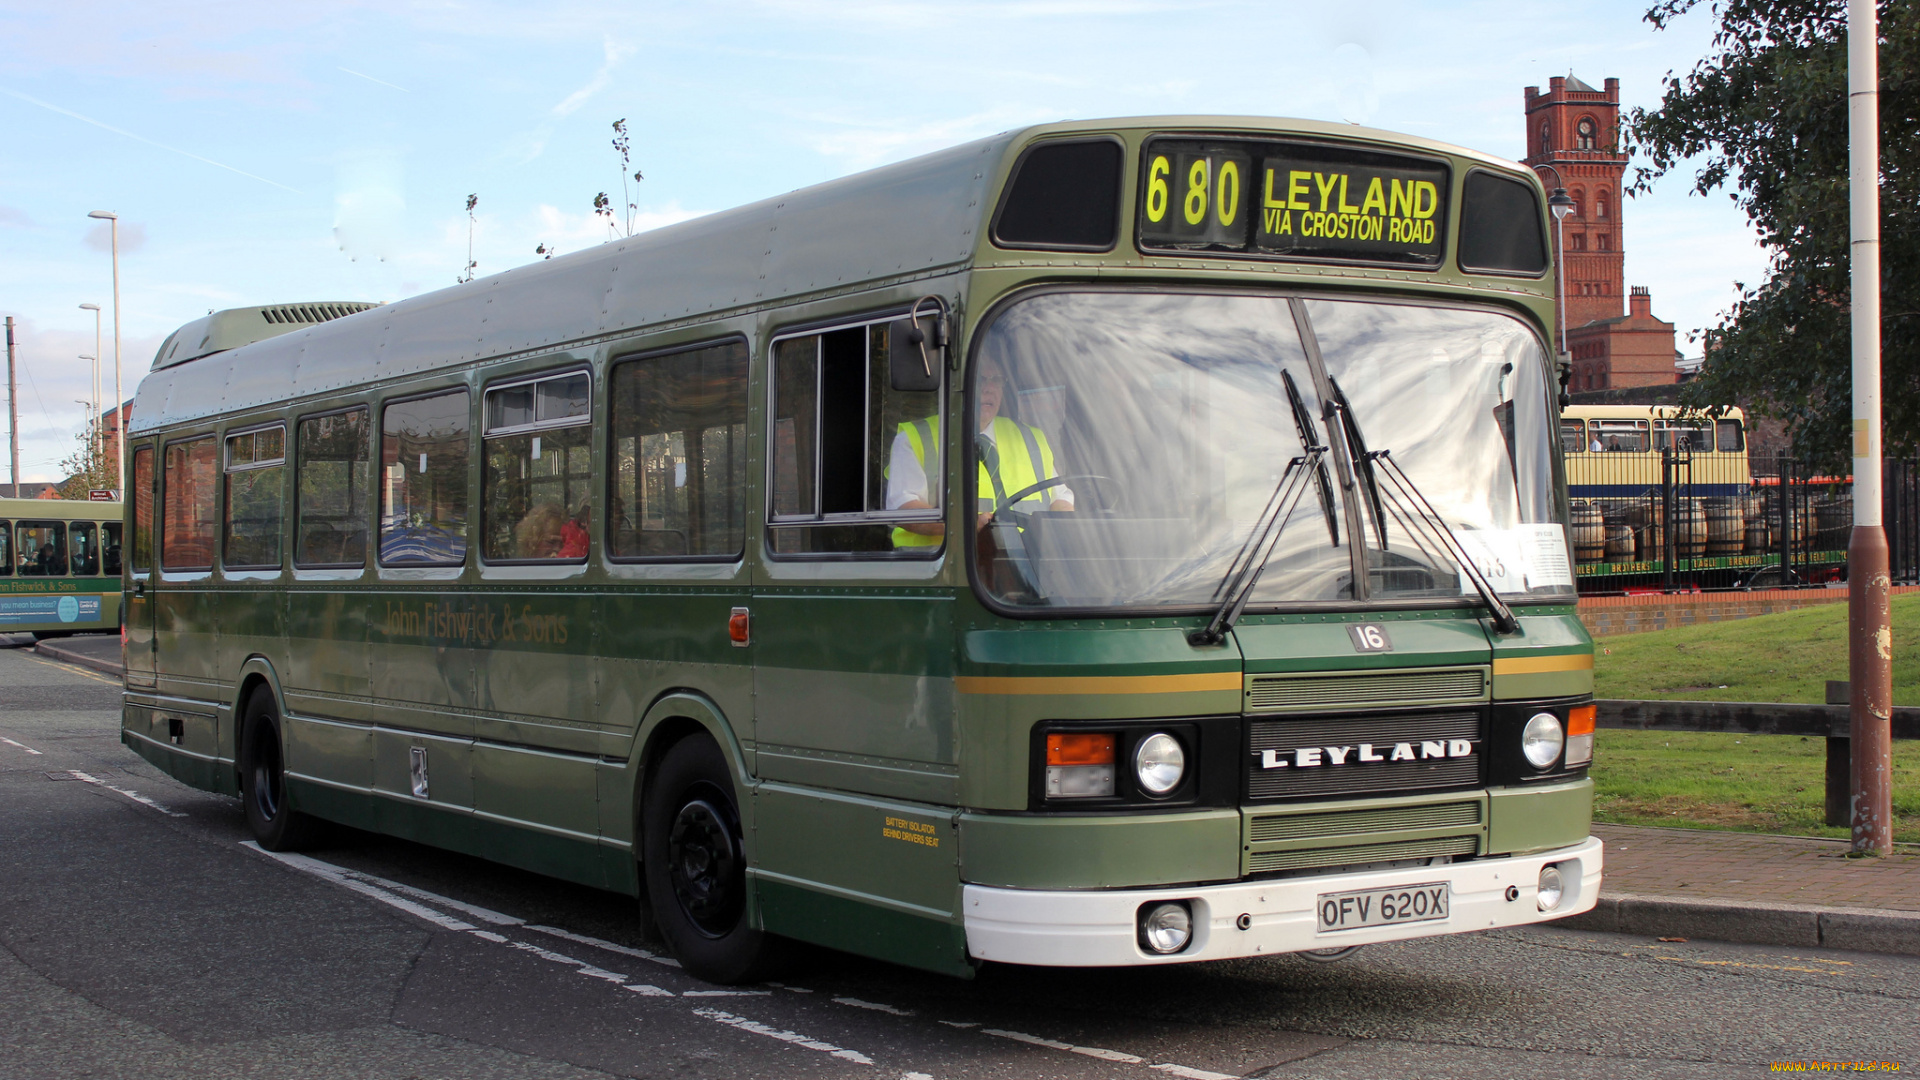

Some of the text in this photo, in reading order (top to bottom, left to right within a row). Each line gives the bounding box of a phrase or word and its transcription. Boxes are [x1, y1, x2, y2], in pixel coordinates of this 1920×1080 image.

[1146, 155, 1239, 226] 680
[1263, 168, 1437, 219] LEYLAND
[1264, 209, 1435, 244] VIA CROSTON ROAD
[11, 581, 46, 592] Fishwick
[58, 582, 77, 591] Sons
[381, 601, 569, 644] John Fishwick & Sons
[1355, 624, 1385, 649] 16
[1261, 739, 1472, 769] LEYLAND
[883, 827, 939, 848] BEHIND DRIVERS SEAT
[885, 816, 936, 835] BATTERY ISOLATOR
[1323, 888, 1444, 927] OFV 620X
